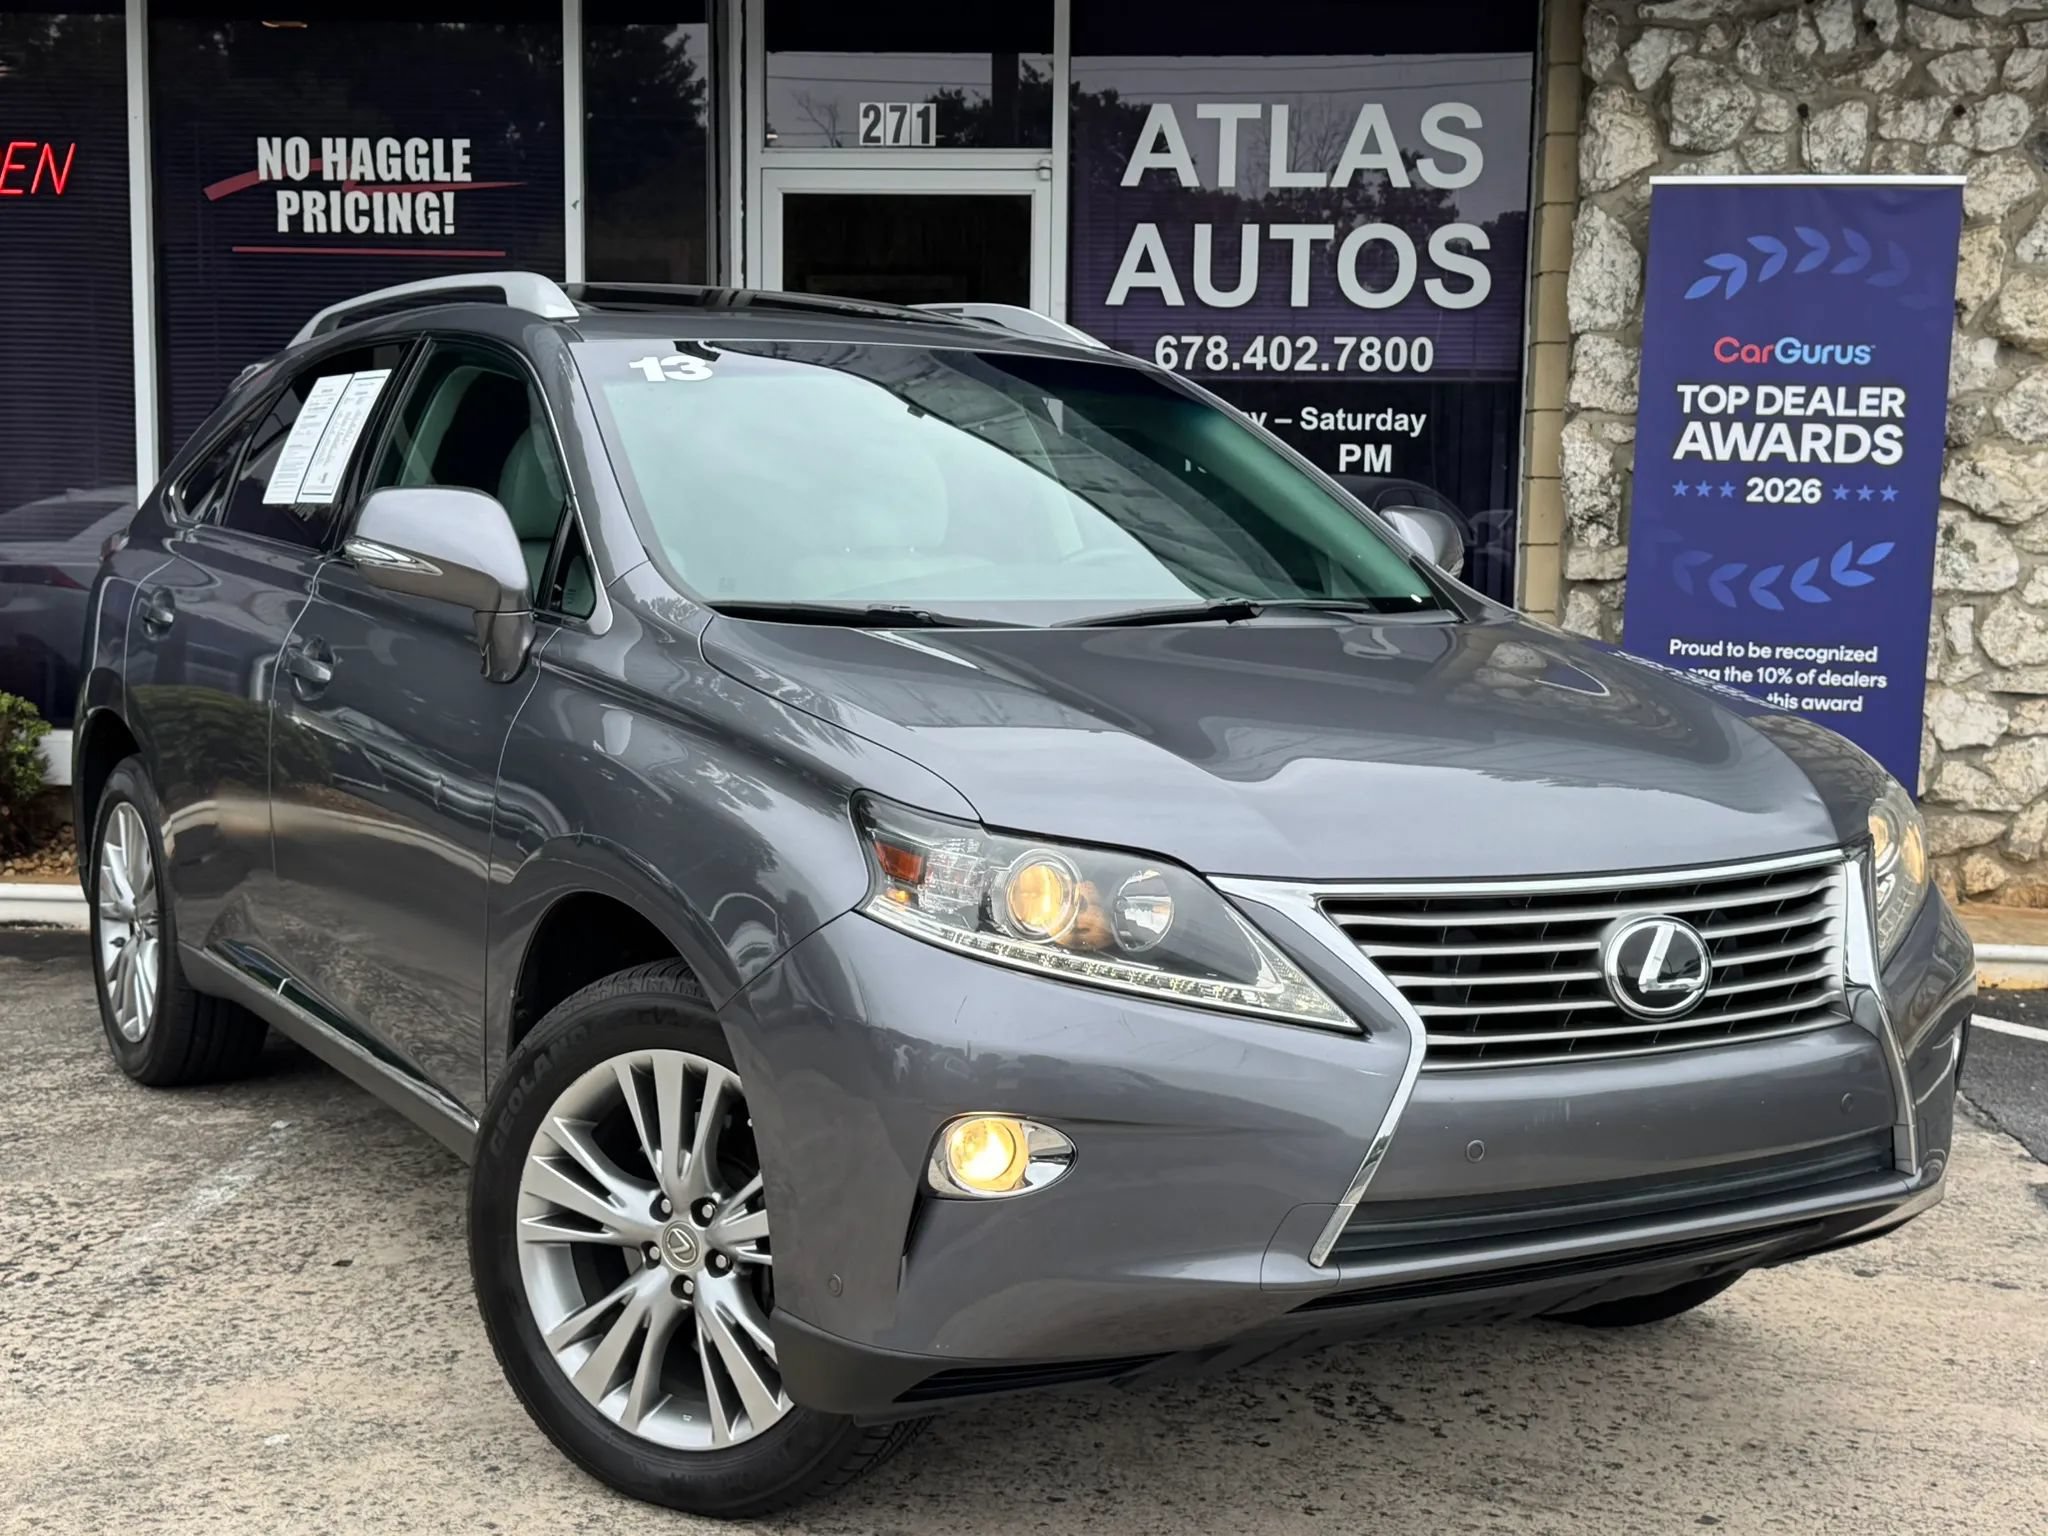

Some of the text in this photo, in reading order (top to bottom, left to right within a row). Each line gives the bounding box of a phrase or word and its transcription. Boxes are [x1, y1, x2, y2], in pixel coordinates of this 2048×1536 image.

[861, 103, 931, 145] 271
[257, 136, 472, 182] NO HAGGLE
[1119, 102, 1484, 189] ATLAS
[276, 190, 455, 235] PRICING!
[1105, 222, 1491, 310] AUTOS
[1155, 335, 1435, 373] 678.402.7800
[1714, 336, 1872, 365] CarGurus
[628, 355, 713, 382] 13
[1676, 384, 1906, 418] TOP DEALER
[1300, 406, 1427, 438] Saturday
[1338, 444, 1393, 473] PM
[1672, 421, 1904, 465] AWARDS
[1745, 477, 1823, 504] 2026
[1669, 639, 1879, 664] Proud to be recognized
[1724, 666, 1753, 683] the
[1756, 667, 1793, 684] 10%
[1796, 668, 1816, 685] of
[1818, 670, 1888, 688] dealers
[1801, 695, 1864, 712] award
